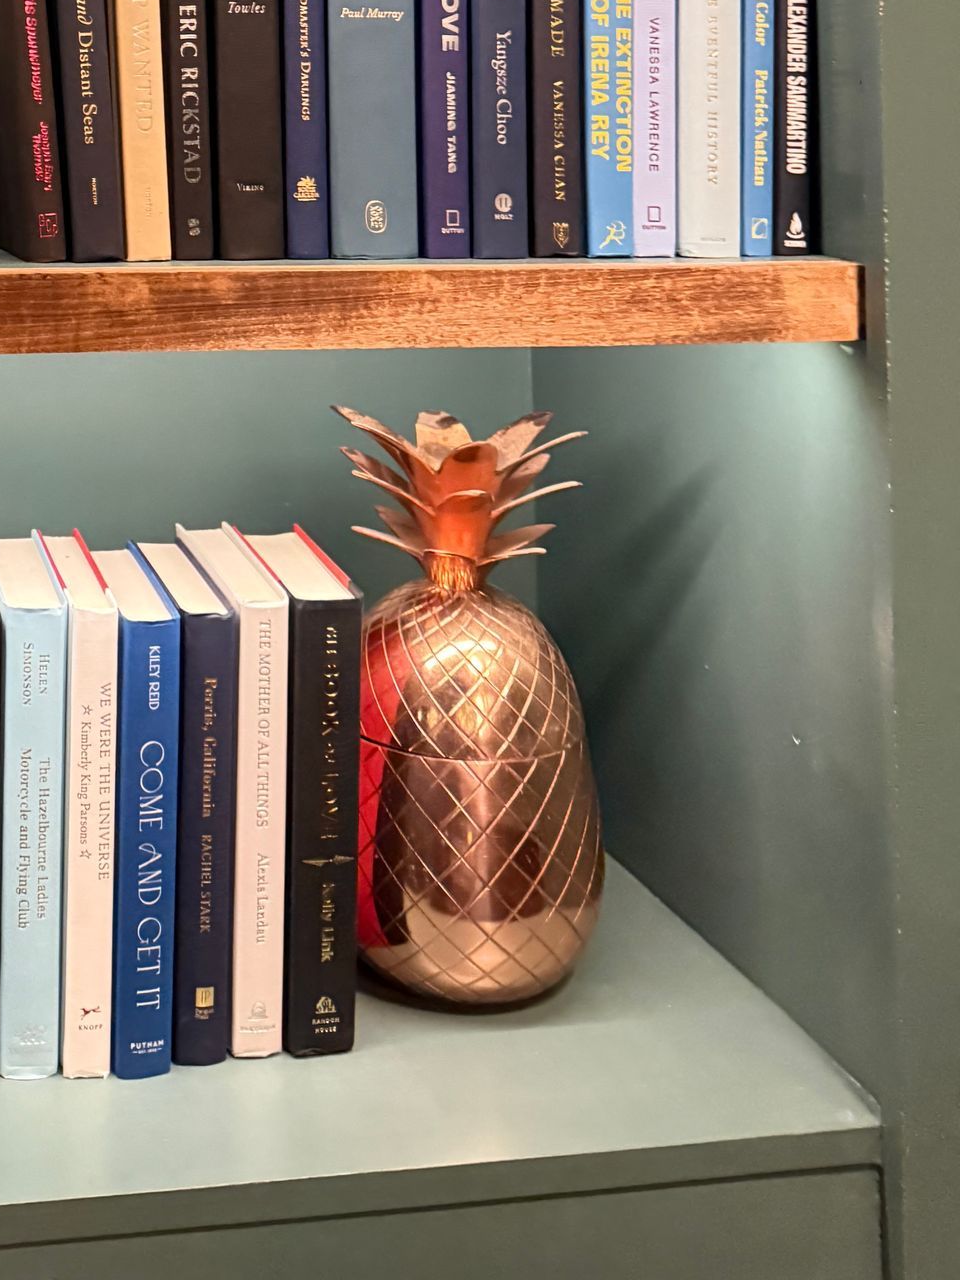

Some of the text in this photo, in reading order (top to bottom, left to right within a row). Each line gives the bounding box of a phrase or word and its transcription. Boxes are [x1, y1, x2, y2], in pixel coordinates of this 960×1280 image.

[178, 4, 198, 57] ERIC
[227, 2, 266, 13] Towles
[341, 8, 404, 22] Paul Murray
[77, 31, 94, 96] Distant
[491, 30, 513, 94] Yangsze
[591, 35, 608, 106] IRENA
[648, 17, 660, 85] VANESSA
[81, 103, 97, 145] Seas
[181, 67, 201, 183] RICKSTAD
[446, 72, 457, 131] JIAMING
[496, 99, 513, 145] Choo
[552, 80, 565, 149] VANESSA
[615, 27, 632, 172] EXTINCTION
[648, 91, 660, 172] LAWRENCE
[785, 76, 808, 175] SAMMARTINO
[447, 136, 457, 174] TANG
[591, 115, 608, 160] REY
[553, 155, 566, 201] CHAN
[76, 721, 92, 844] Kimberly King Parsons
[96, 682, 112, 880] WE WERE THE UNIVERSE
[135, 645, 164, 1010] KILEY REID COME AND GET IT
[130, 1041, 164, 1051] PUTNAM
